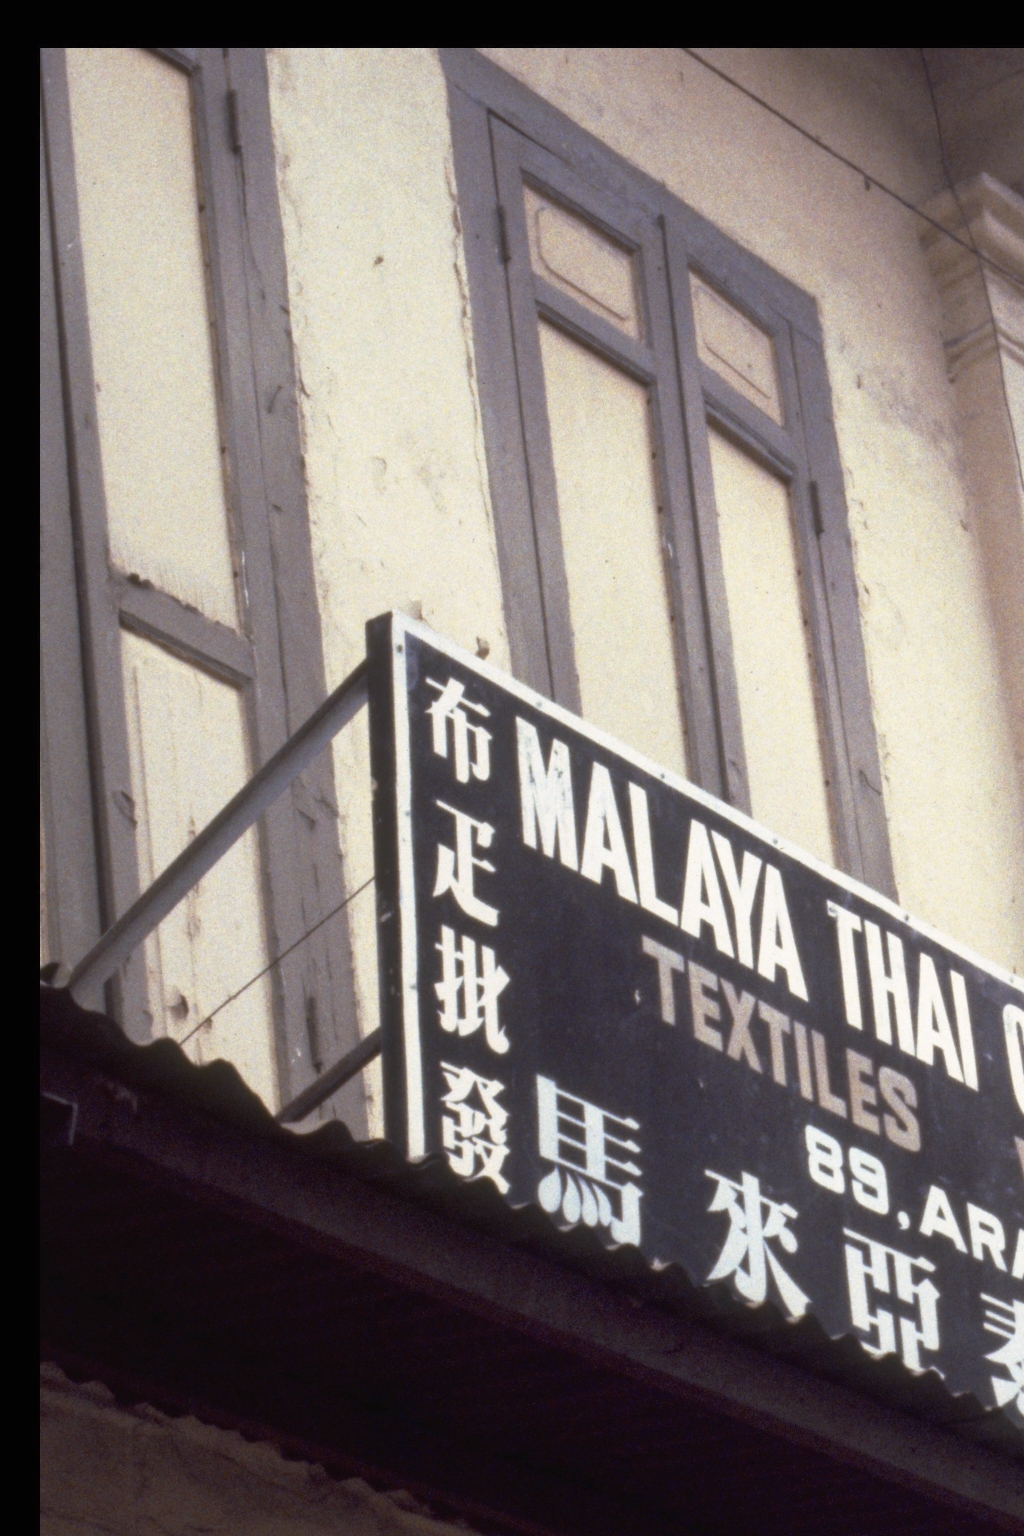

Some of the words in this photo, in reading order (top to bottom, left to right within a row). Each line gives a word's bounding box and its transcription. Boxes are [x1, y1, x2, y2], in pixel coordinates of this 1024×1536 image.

[516, 716, 809, 1002] MALAYA
[827, 900, 979, 1092] THAI
[641, 934, 921, 1153] TEXTILES
